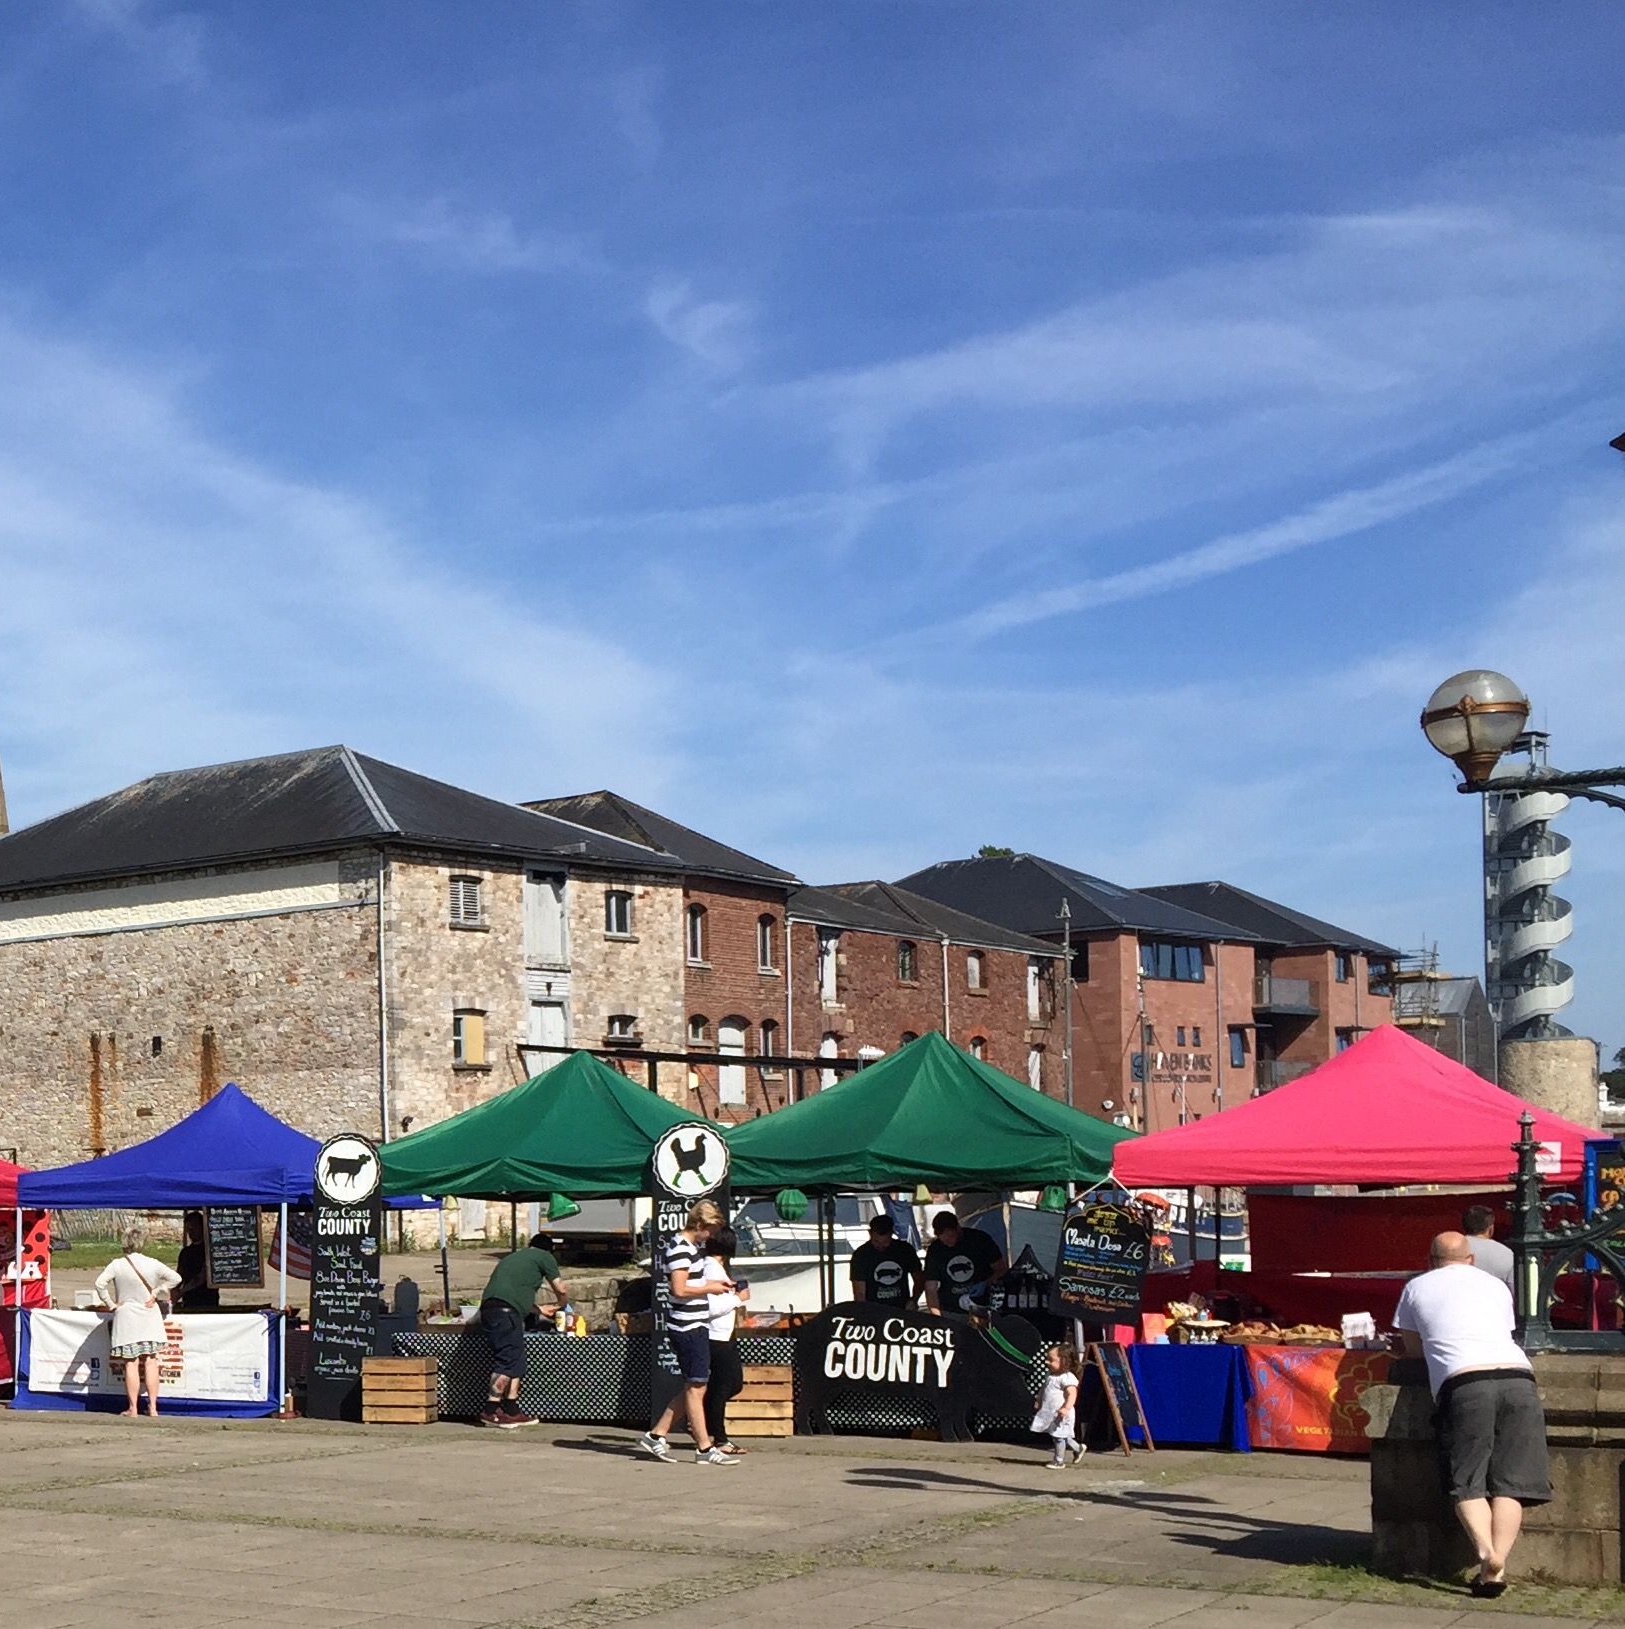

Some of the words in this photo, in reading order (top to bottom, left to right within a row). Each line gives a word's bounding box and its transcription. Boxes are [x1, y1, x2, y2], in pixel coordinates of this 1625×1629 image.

[318, 1206, 340, 1218] Two
[341, 1206, 371, 1218] Coast
[658, 1200, 682, 1213] Two
[317, 1218, 371, 1235] COUNTY
[658, 1212, 688, 1231] COU
[1065, 1228, 1096, 1248] Masala
[1098, 1234, 1122, 1251] Dosa
[1123, 1241, 1144, 1260] £6
[1059, 1276, 1106, 1296] Samosas
[1108, 1285, 1125, 1299] £2
[831, 1316, 876, 1342] Two
[883, 1317, 955, 1348] Coast
[824, 1341, 955, 1388] COUNTY
